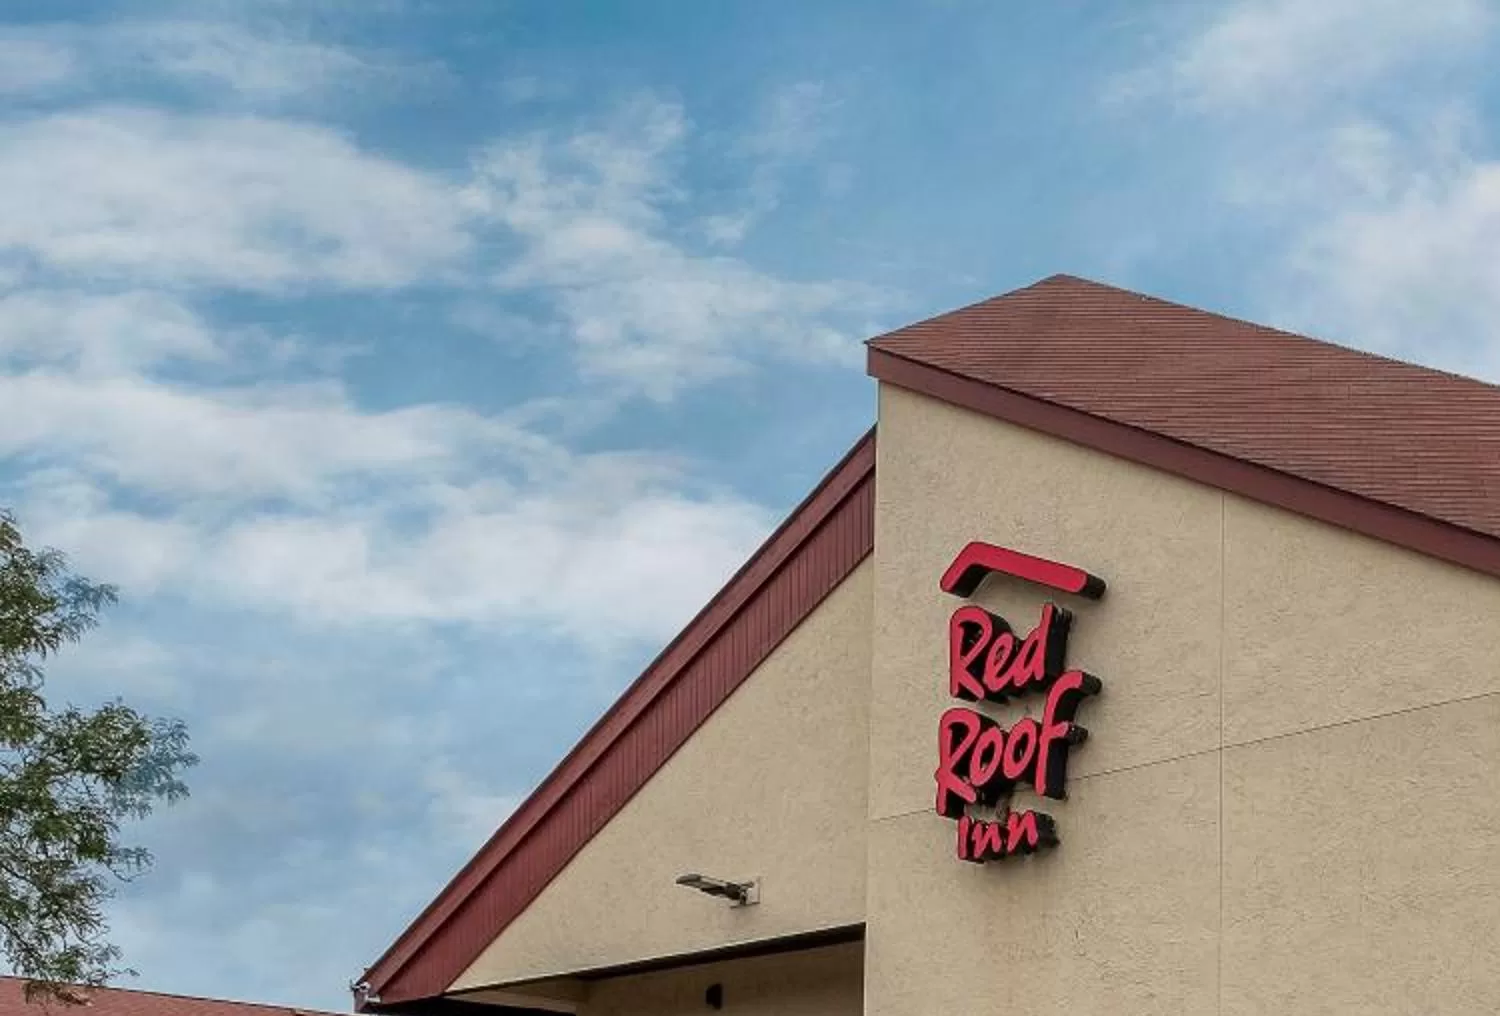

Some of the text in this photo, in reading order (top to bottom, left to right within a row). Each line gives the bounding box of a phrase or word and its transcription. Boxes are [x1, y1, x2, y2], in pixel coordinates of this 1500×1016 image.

[949, 602, 1055, 700] Red
[936, 670, 1084, 816] Roof
[958, 809, 1040, 860] Inn
